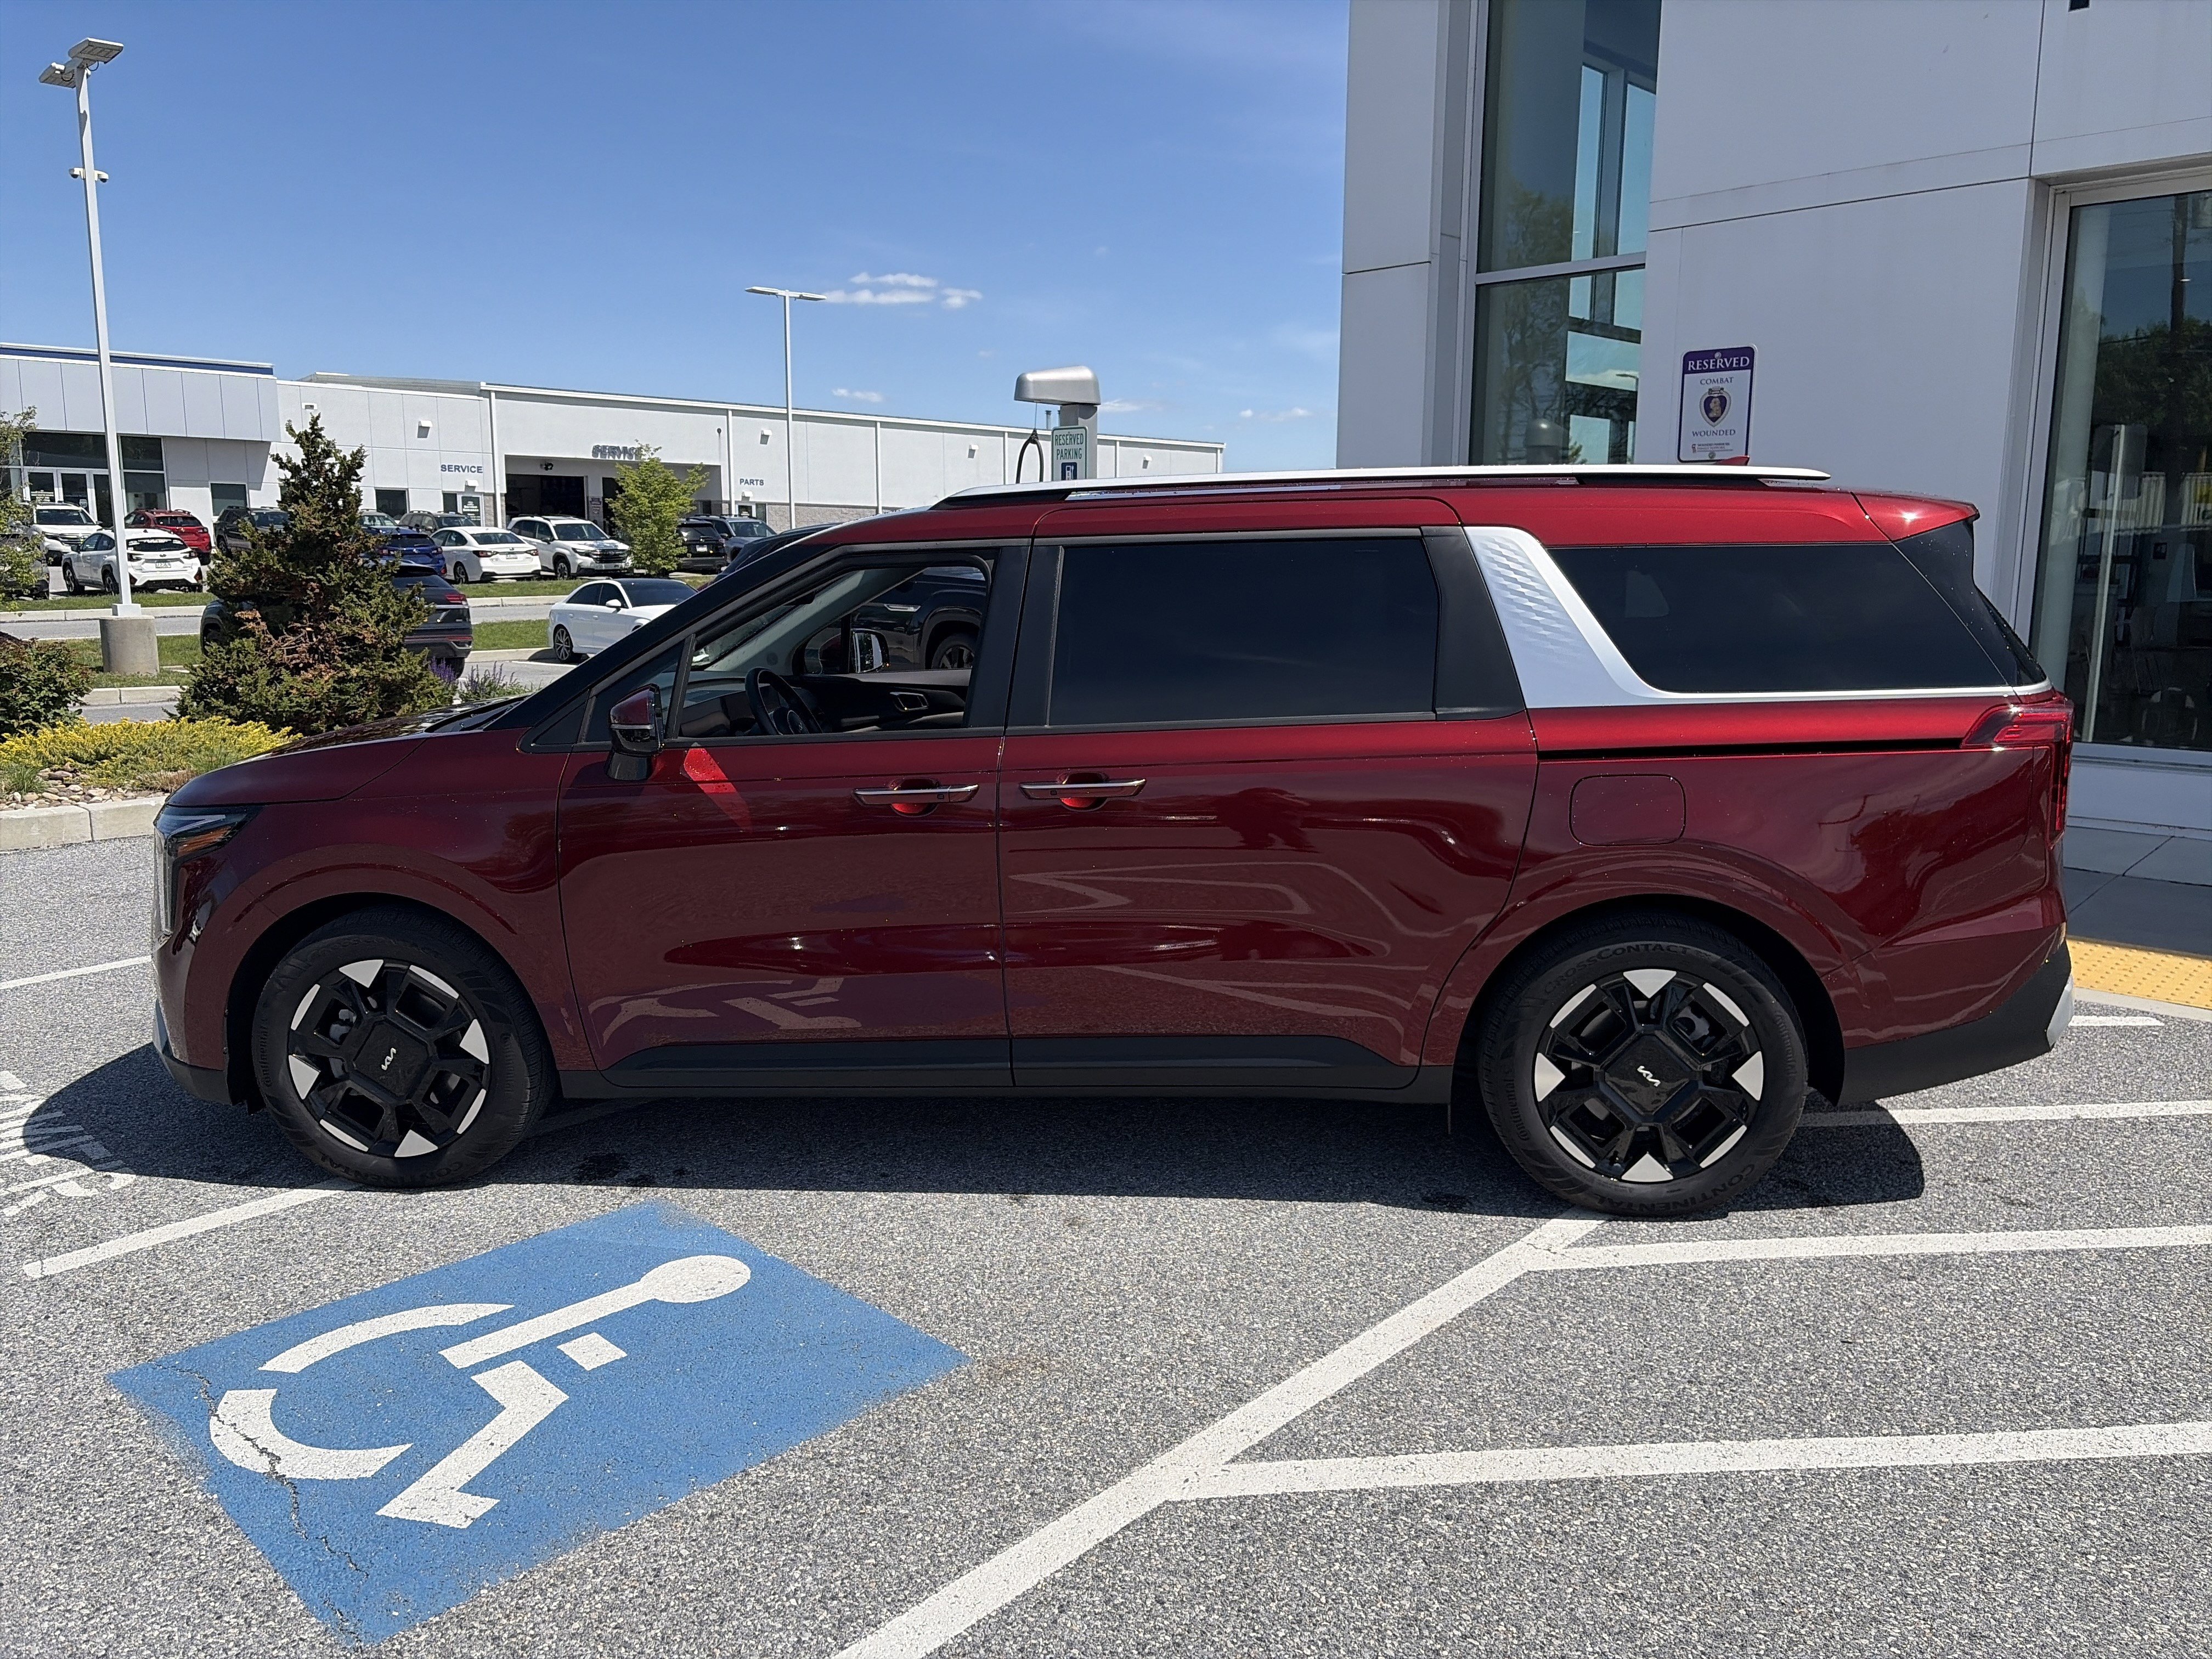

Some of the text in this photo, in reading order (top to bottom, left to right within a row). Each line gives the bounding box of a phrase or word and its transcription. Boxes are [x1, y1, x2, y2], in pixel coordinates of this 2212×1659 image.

[1688, 357, 1750, 371] RESERVED
[1700, 377, 1734, 385] COMBAT
[1054, 433, 1084, 445] RESERVED
[1056, 448, 1082, 460] PARKING
[441, 464, 483, 473] SERVICE
[381, 1047, 397, 1071] KIA
[1637, 1065, 1661, 1087] KIA
